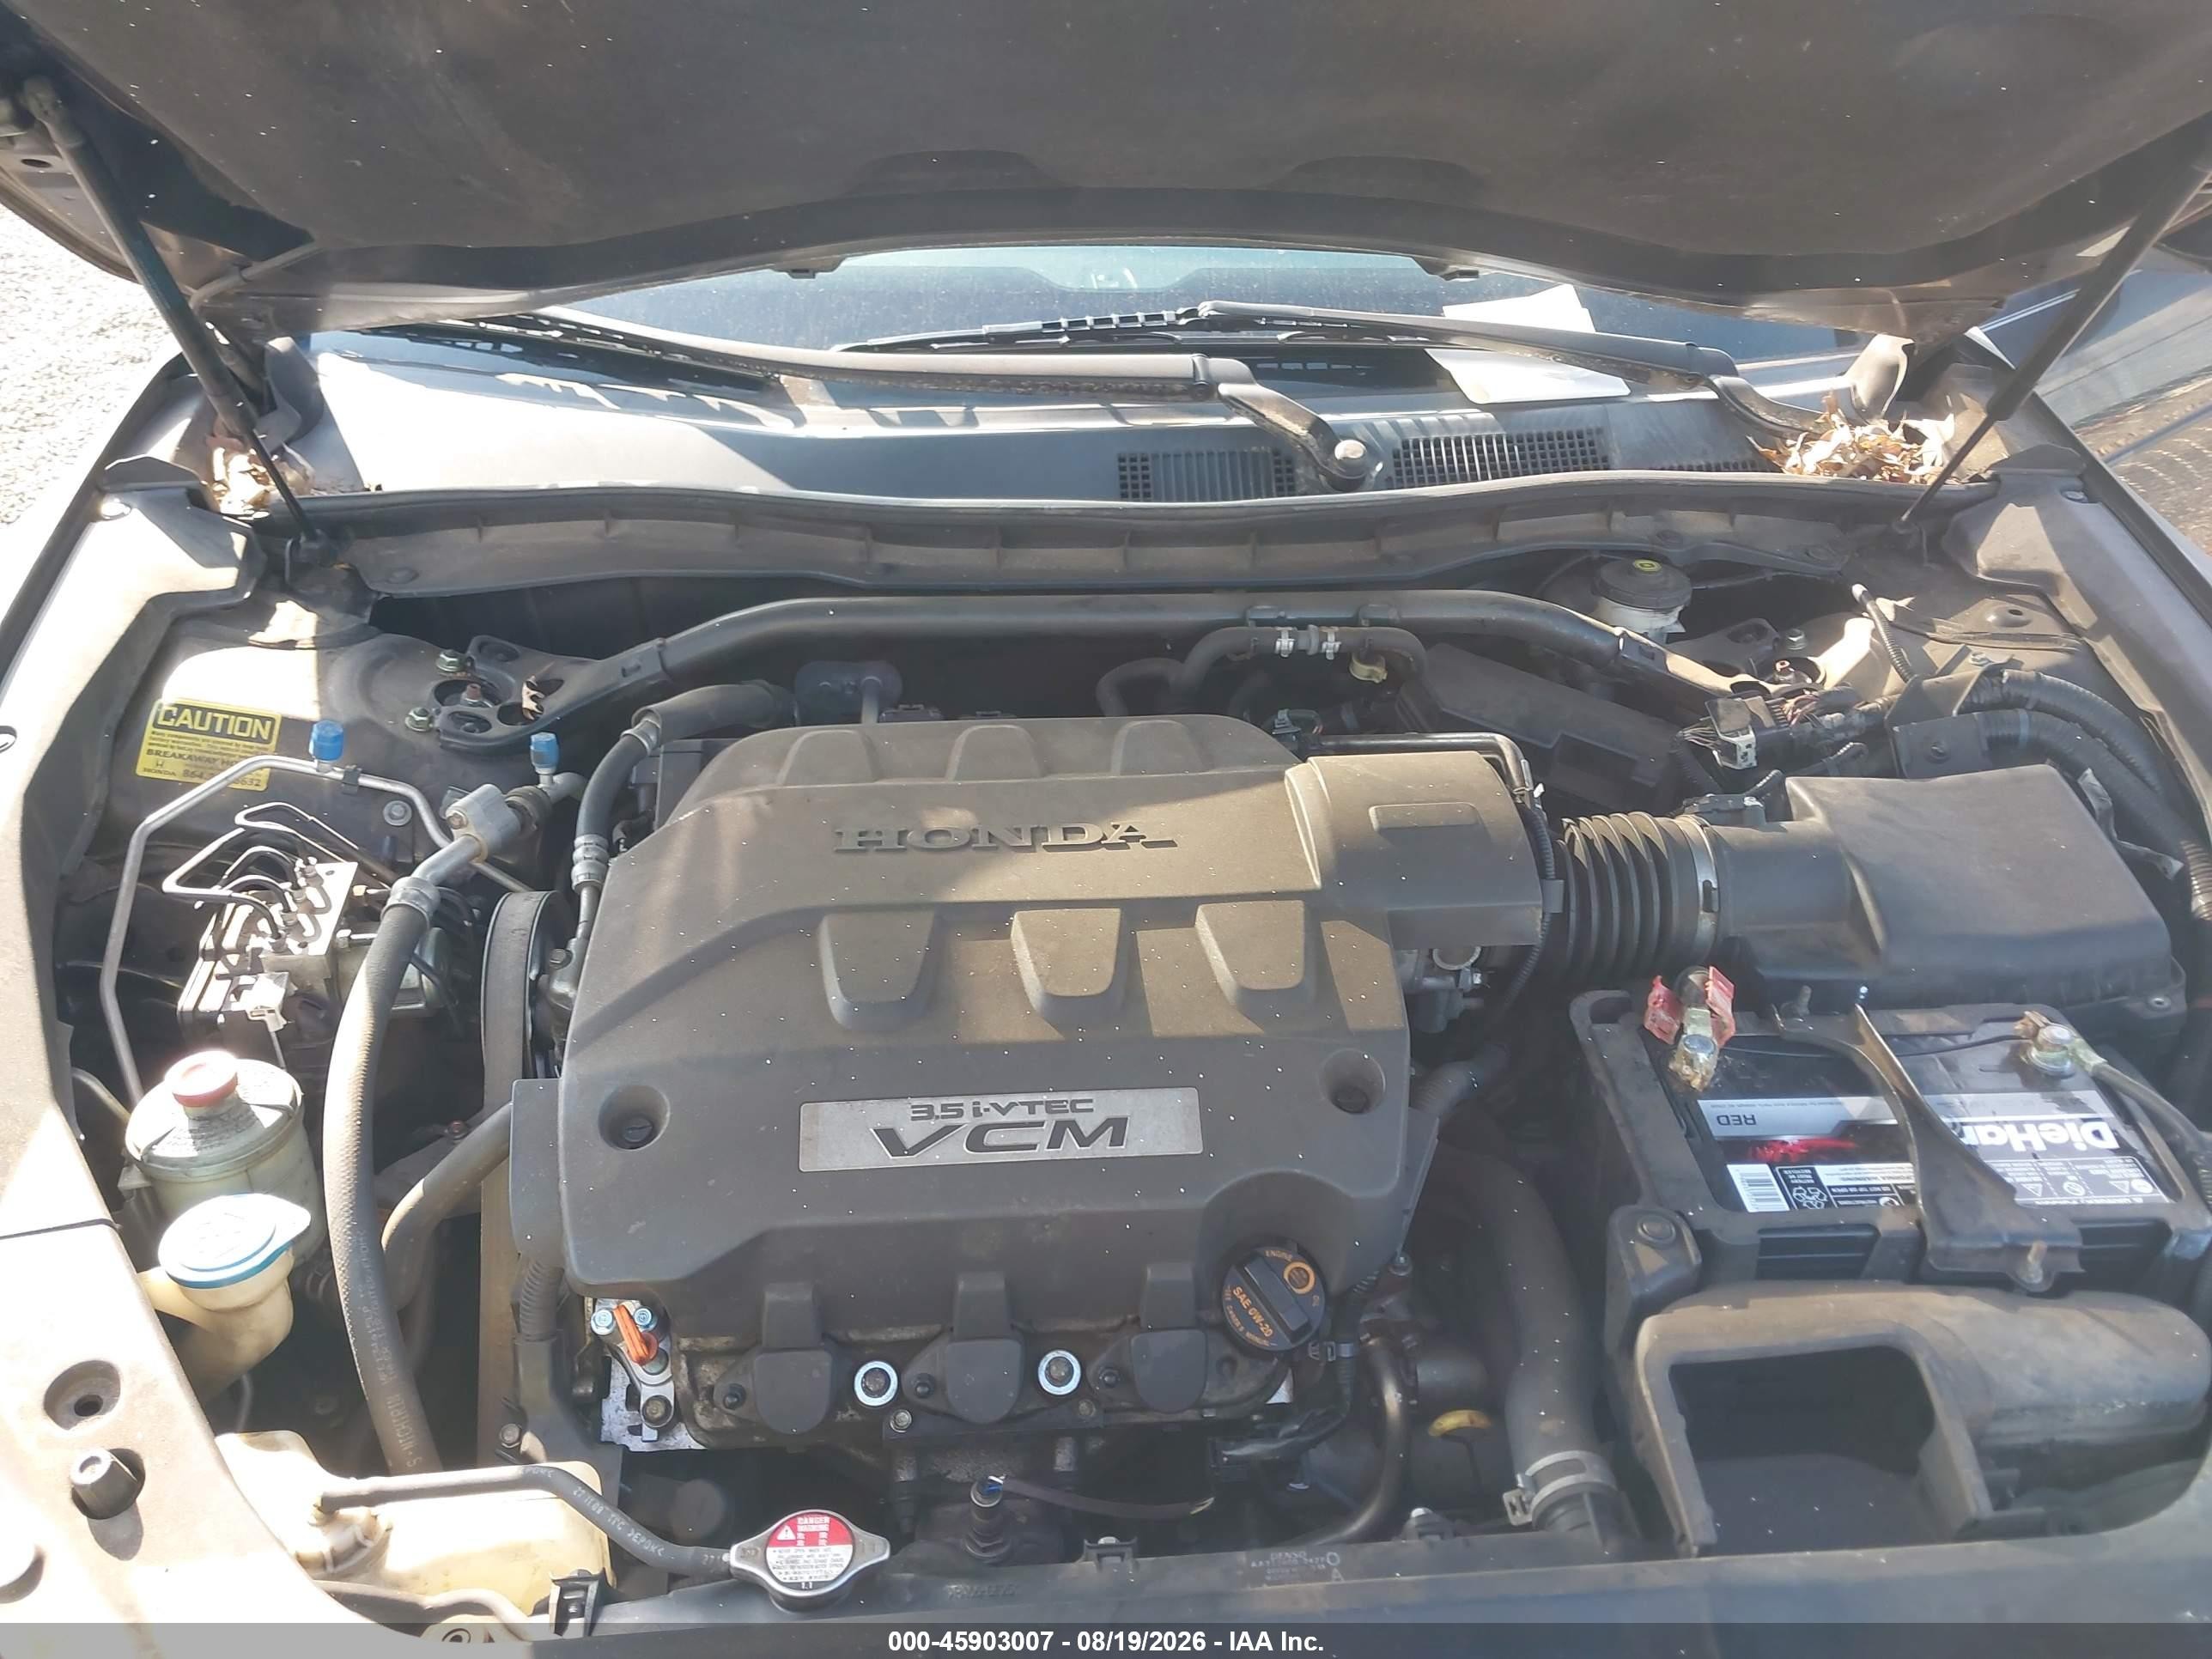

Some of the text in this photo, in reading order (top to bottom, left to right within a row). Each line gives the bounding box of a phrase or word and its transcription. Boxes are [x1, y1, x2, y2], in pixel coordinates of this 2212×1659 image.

[156, 706, 272, 740] CAUTION
[143, 767, 177, 777] HONDA
[146, 748, 220, 765] BREAKAWAY
[834, 822, 1178, 853] HONDA
[910, 1098, 1095, 1121] 3.5 i-VTEC
[1717, 1114, 1757, 1127] RED
[870, 1115, 1130, 1159] VCM
[1957, 1120, 2120, 1152] DieHar
[1232, 1286, 1252, 1310] SAE
[1248, 1307, 1273, 1337] 0W-20
